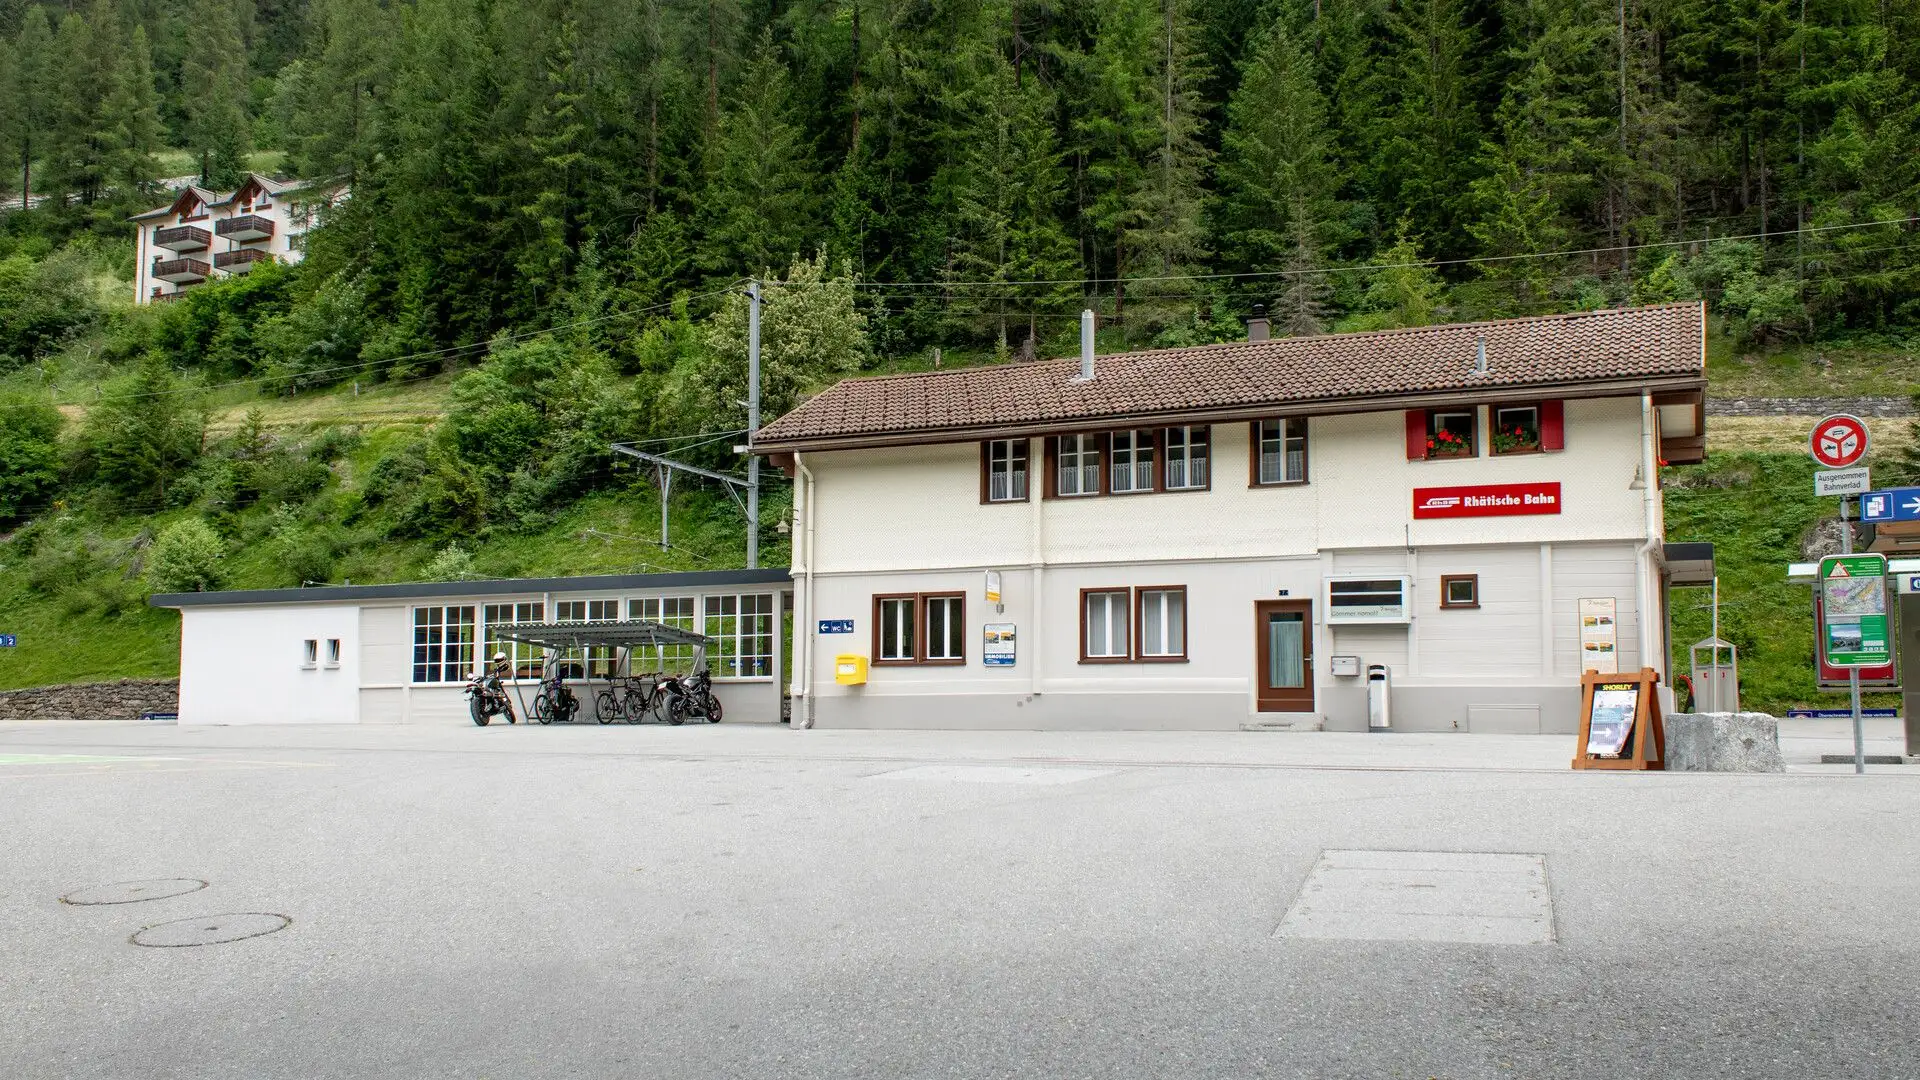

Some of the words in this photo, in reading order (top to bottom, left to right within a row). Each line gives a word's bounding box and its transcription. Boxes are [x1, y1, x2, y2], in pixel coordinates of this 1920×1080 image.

[1817, 472, 1867, 482] Ausgenommen
[1823, 481, 1861, 491] Bahnverlad
[1463, 494, 1520, 507] Rhätische
[1524, 493, 1555, 505] Bahn
